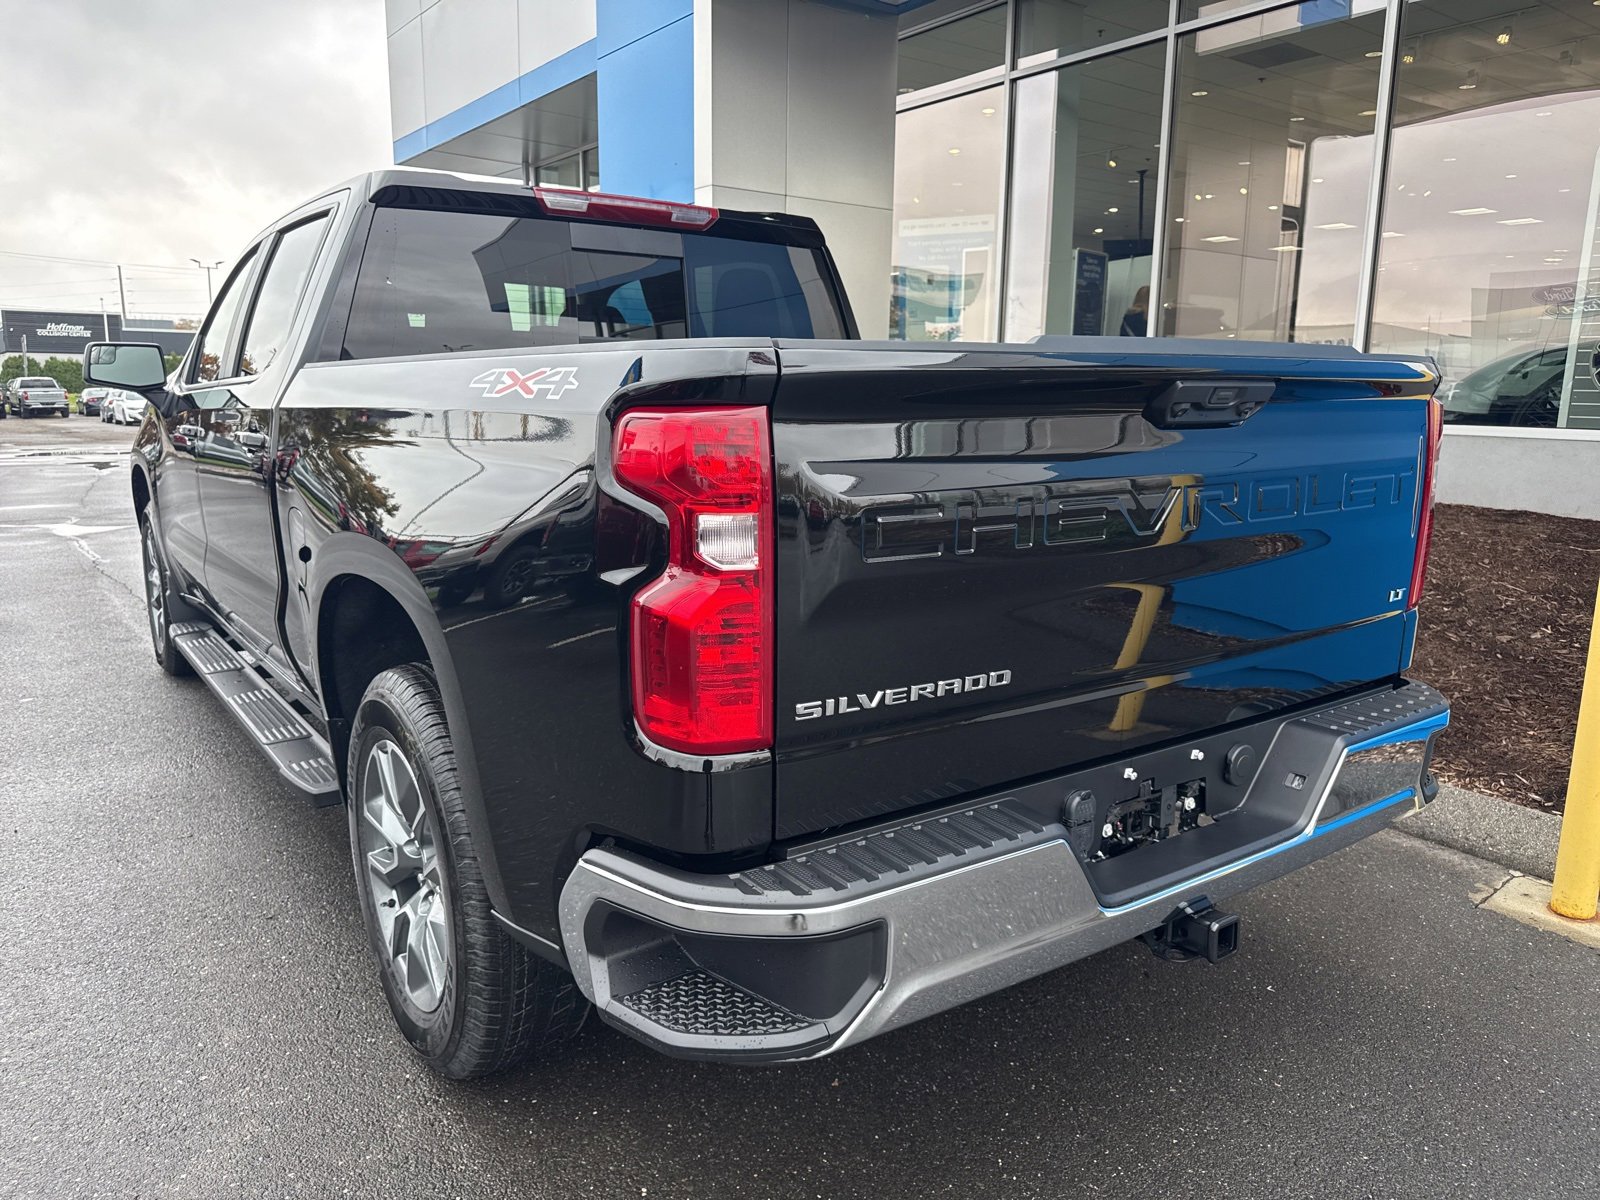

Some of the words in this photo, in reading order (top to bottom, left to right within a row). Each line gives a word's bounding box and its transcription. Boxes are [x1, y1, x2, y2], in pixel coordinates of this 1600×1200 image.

[46, 323, 84, 331] Hoffman
[861, 467, 1414, 564] CHEVROLET
[1388, 587, 1407, 603] LT
[795, 669, 1012, 721] SILVERADO
